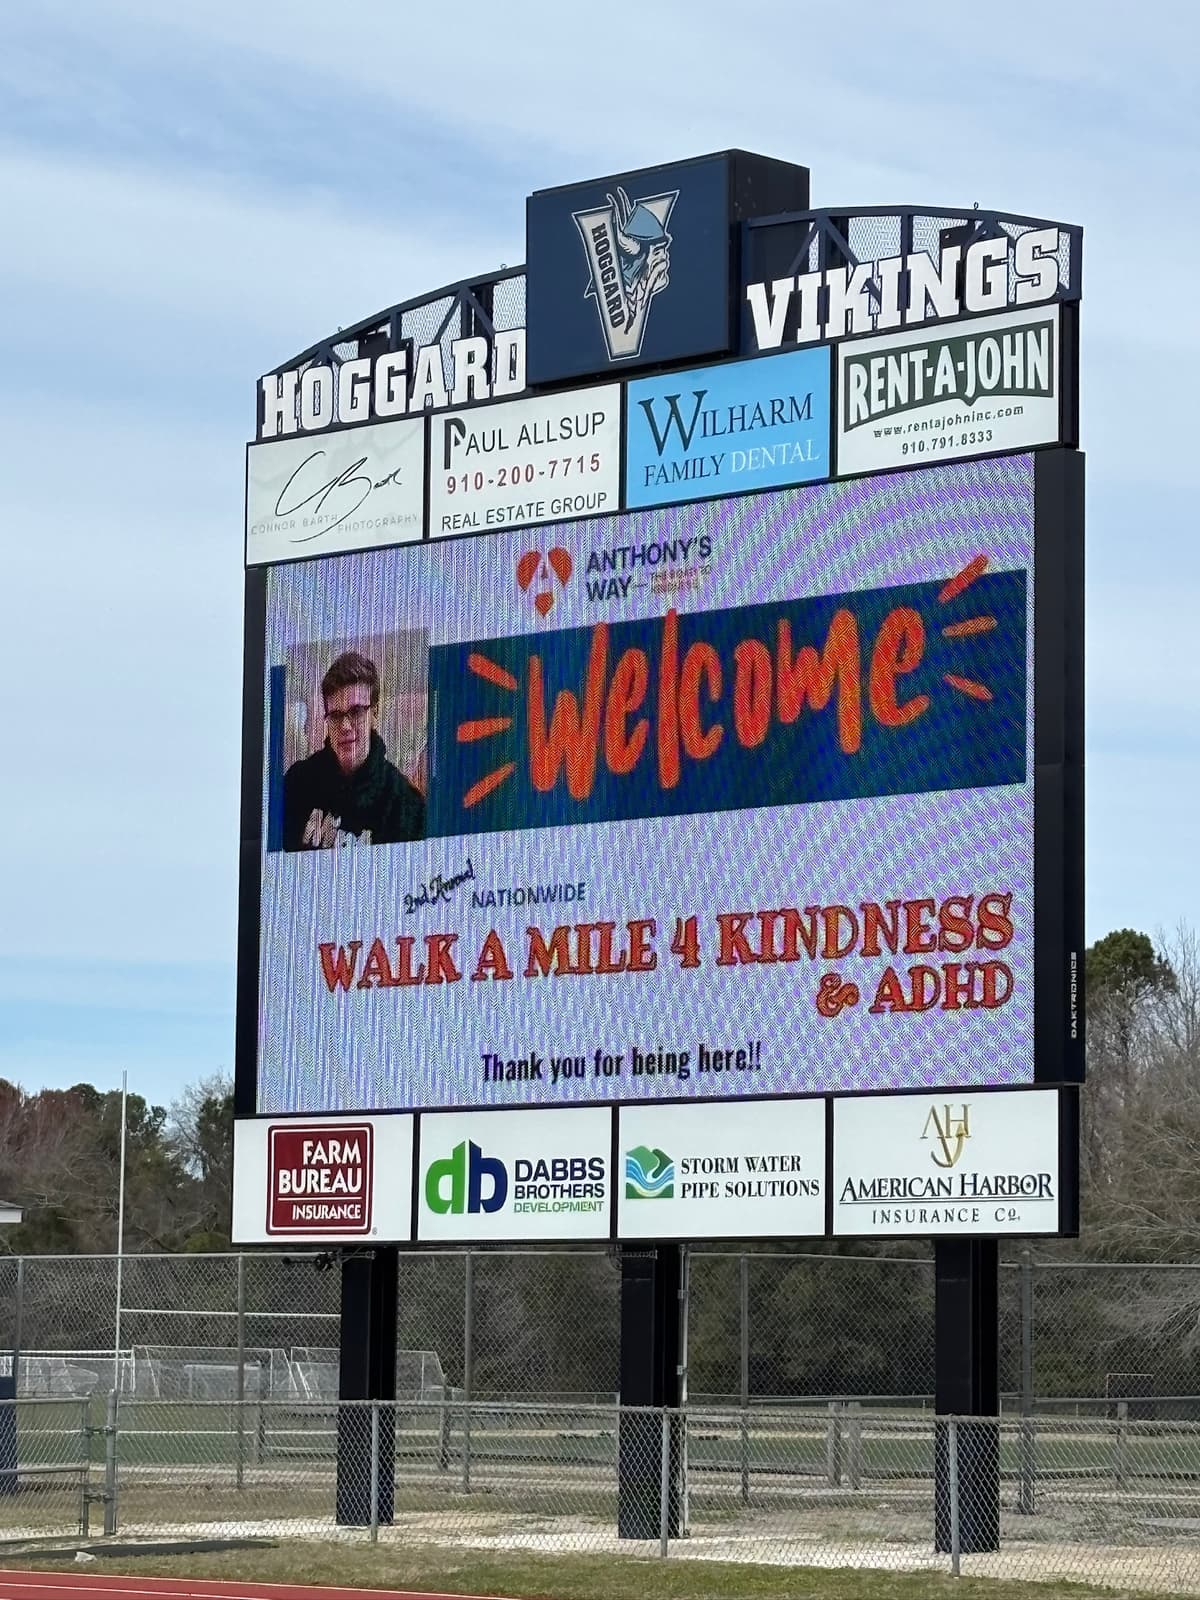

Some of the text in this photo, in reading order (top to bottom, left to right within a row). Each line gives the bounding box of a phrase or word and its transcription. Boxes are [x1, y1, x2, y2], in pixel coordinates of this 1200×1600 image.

[591, 222, 625, 329] HOGGARD
[747, 228, 1058, 351] VIKINGS
[261, 328, 526, 438] HOGGARD
[848, 327, 1049, 427] RENT-A-JOHN
[639, 390, 814, 457] WILHARM
[873, 405, 1024, 438] www.rentajohninc.com
[444, 411, 606, 470] PAUL ALLSUP
[902, 429, 994, 455] 910.791.8333
[446, 453, 600, 494] 910-200-7715
[644, 439, 820, 487] FAMILY DENTAL
[442, 493, 607, 532] REAL ESTATE GROUP
[587, 536, 712, 573] ANTHONY'S
[586, 576, 632, 602] WAY
[471, 882, 586, 909] NATIONWIDE
[318, 892, 1014, 993] WALK A MILE 4 KINDNESS
[816, 961, 1015, 1017] & ADHD
[482, 1041, 761, 1084] Thank you for being here!!
[303, 1139, 361, 1165] FARM
[681, 1155, 801, 1175] STORM WATER
[278, 1168, 362, 1194] BUREAU
[515, 1158, 604, 1182] DABBS
[515, 1183, 604, 1199] BROTHERS
[680, 1179, 820, 1199] PIPE SOLUTIONS
[840, 1172, 1055, 1202] AMERICAN HARBOR
[292, 1204, 361, 1220] INSURANCE
[514, 1200, 604, 1214] DEVELOPMENT
[872, 1208, 980, 1225] INSURANCE
